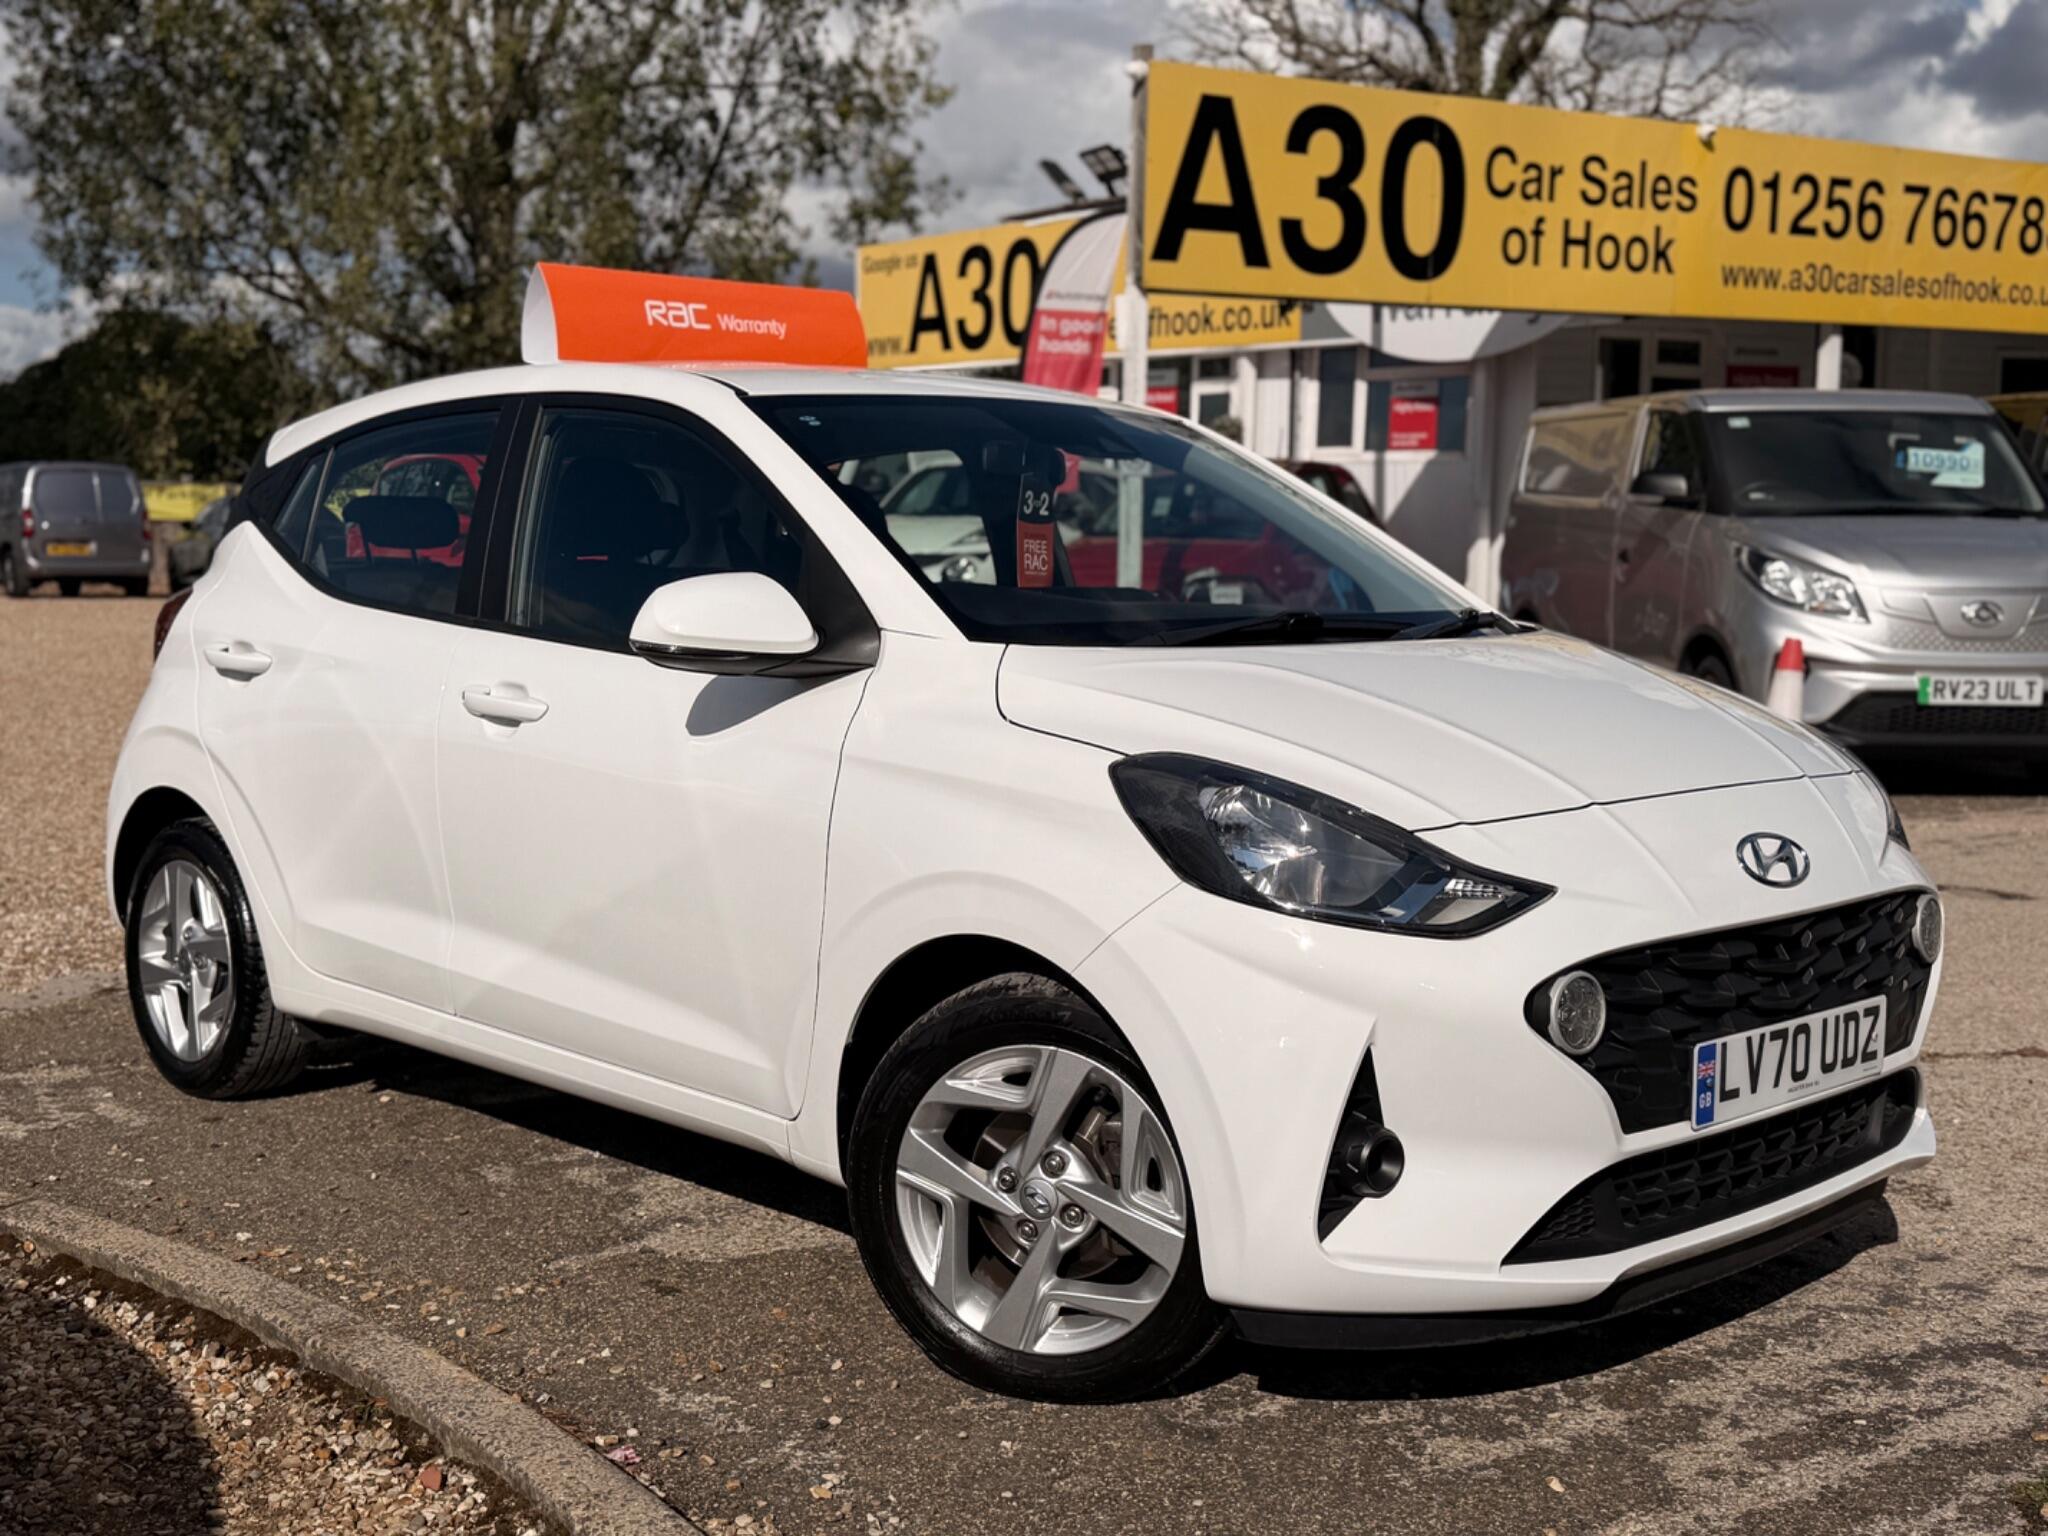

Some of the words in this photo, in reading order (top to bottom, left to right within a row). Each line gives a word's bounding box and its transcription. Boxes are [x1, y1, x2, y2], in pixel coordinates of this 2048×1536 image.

[1150, 93, 1466, 281] A30
[1485, 145, 1563, 204] Car
[1580, 156, 1698, 213] Sales
[1723, 166, 1885, 242] 01256
[1903, 184, 2048, 255] 76678
[1501, 216, 1546, 266] of
[1563, 219, 1675, 275] Hook
[909, 238, 1043, 352] A30
[716, 313, 787, 340] Warranty
[1039, 315, 1057, 331] In
[1060, 316, 1104, 336] good
[1037, 336, 1092, 355] hands
[1023, 538, 1048, 554] FREE
[1024, 553, 1049, 571] RAC
[1933, 680, 1990, 701] RV23
[1995, 680, 2038, 701] ULT
[1718, 1023, 1811, 1103] LV70
[1820, 1004, 1881, 1075] UDZ
[1698, 1091, 1713, 1109] GB
